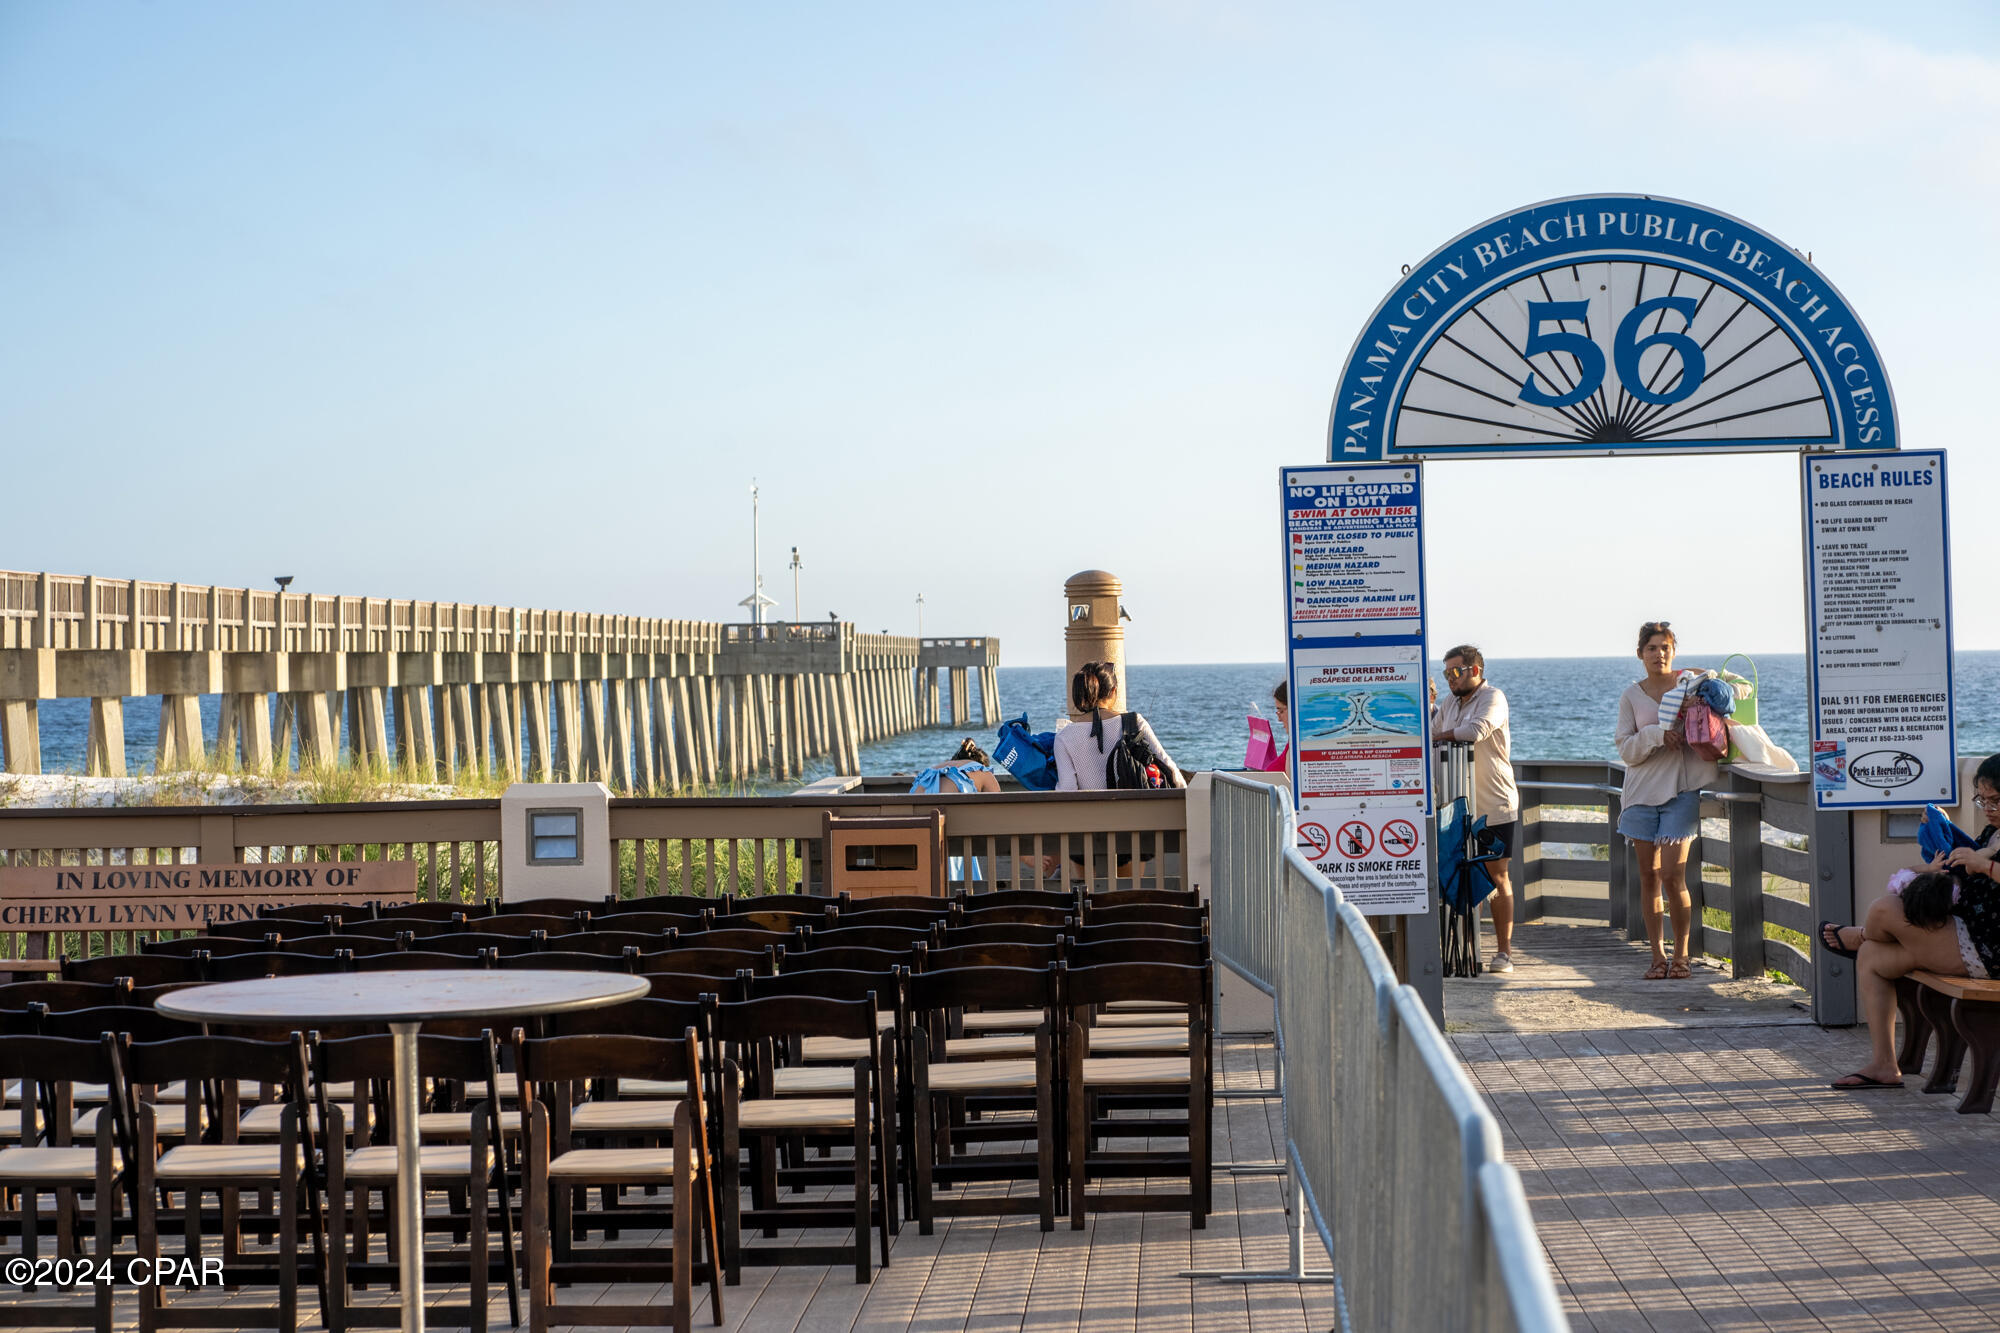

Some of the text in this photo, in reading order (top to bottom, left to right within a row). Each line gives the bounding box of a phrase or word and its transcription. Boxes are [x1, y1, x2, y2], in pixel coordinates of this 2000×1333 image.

[1344, 212, 1881, 453] PANAMA CITY BEACH PUBLIC BEACH ACCESS
[1518, 296, 1706, 408] 56
[1819, 470, 1933, 489] BEACH RULES
[1290, 484, 1413, 497] NO LIFEGUARD
[1315, 496, 1389, 507] ON DUTY
[1293, 507, 1413, 518] SWIM AT OWN RISK
[1327, 518, 1379, 526] WARNING
[1342, 666, 1395, 674] CURRENTS
[1821, 694, 1946, 705] DIAL 911 FOR EMERGENCIES
[1854, 766, 1908, 775] Parks & Recreation
[1316, 860, 1421, 873] PARK IS SMOKE FREE
[56, 867, 361, 890] IN LOVING MEMORY OF
[2, 905, 102, 924] CHERYL
[110, 905, 179, 923] LYNN
